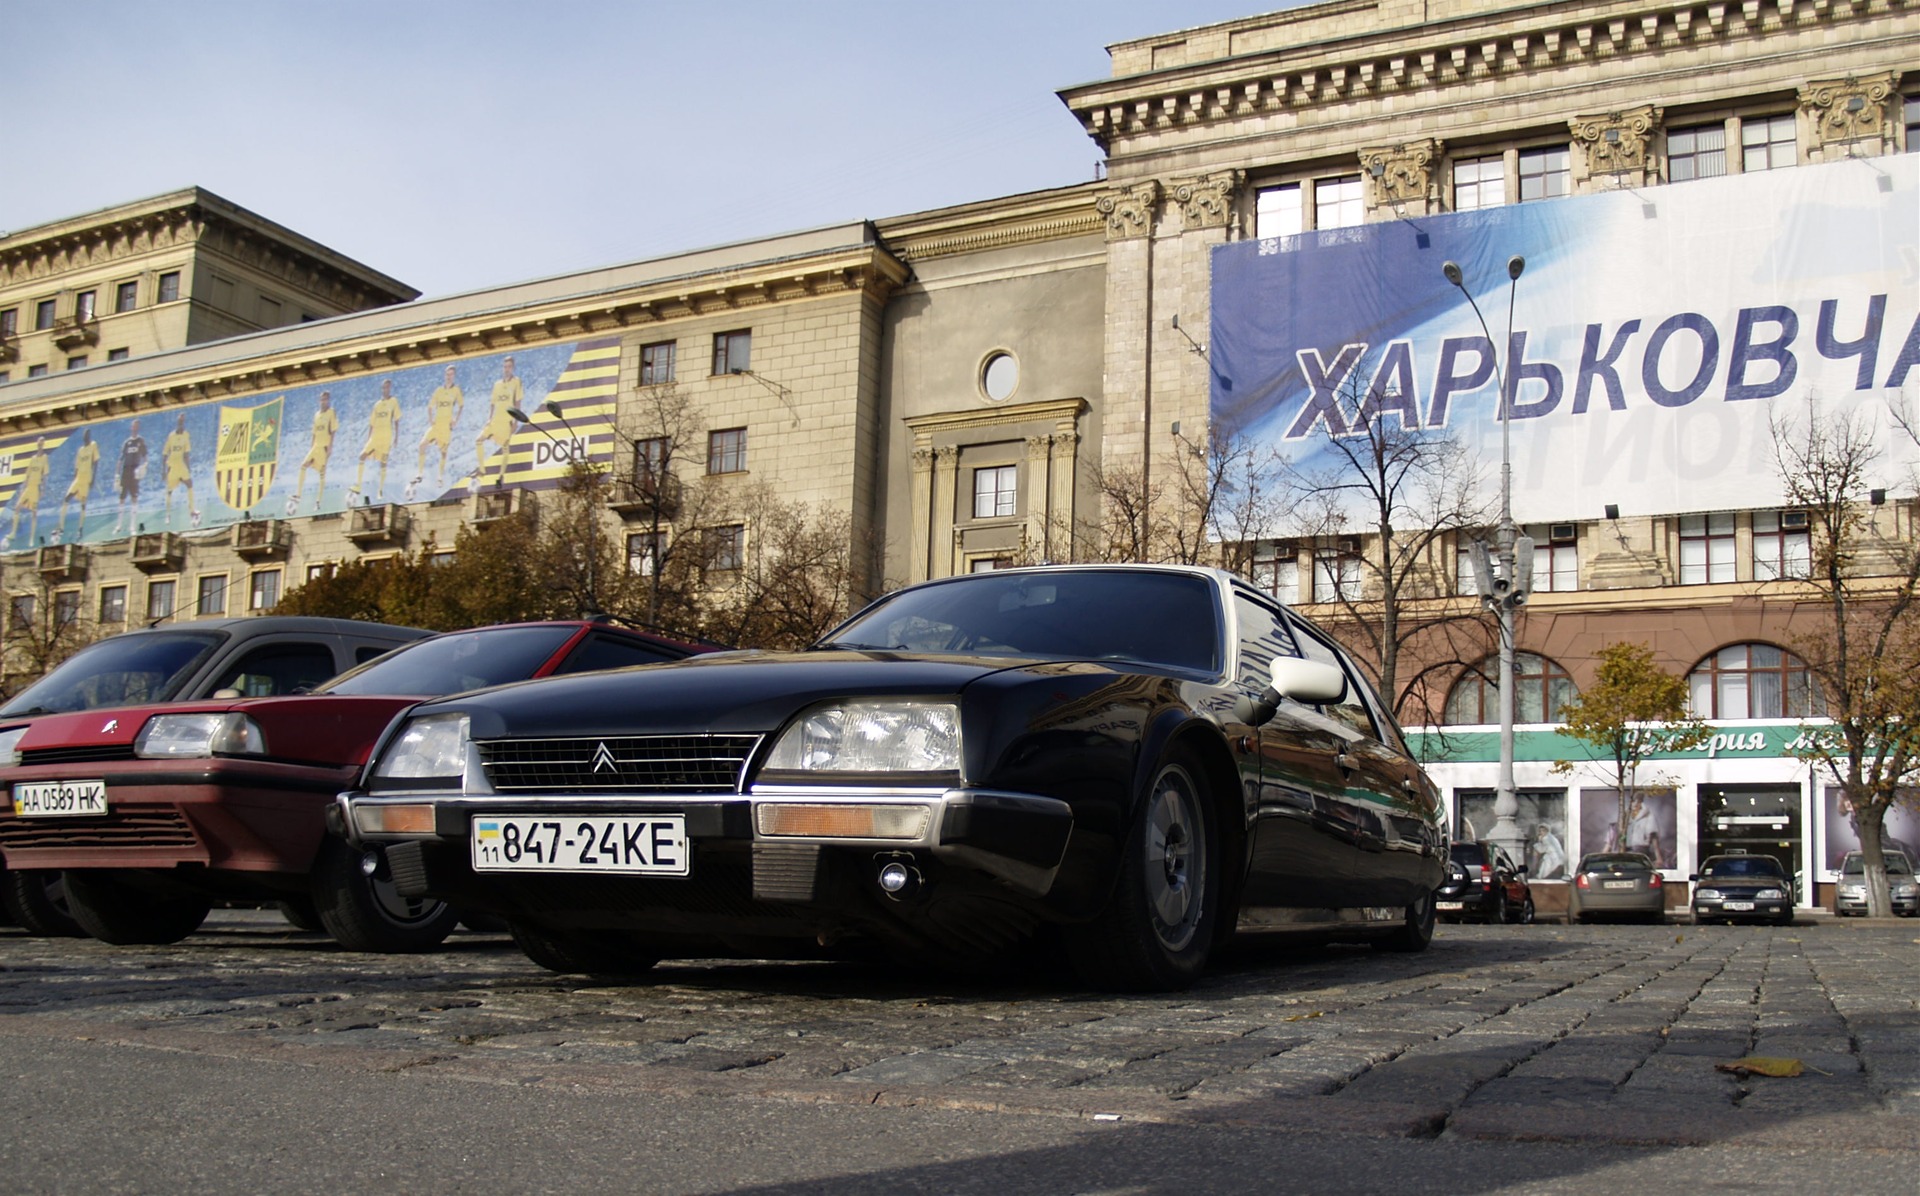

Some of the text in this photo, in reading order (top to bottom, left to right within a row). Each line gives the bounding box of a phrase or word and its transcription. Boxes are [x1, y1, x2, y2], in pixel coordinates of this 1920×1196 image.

[43, 787, 74, 810] 0589
[78, 786, 101, 810] HK
[482, 822, 676, 865] 11 847-24KE
